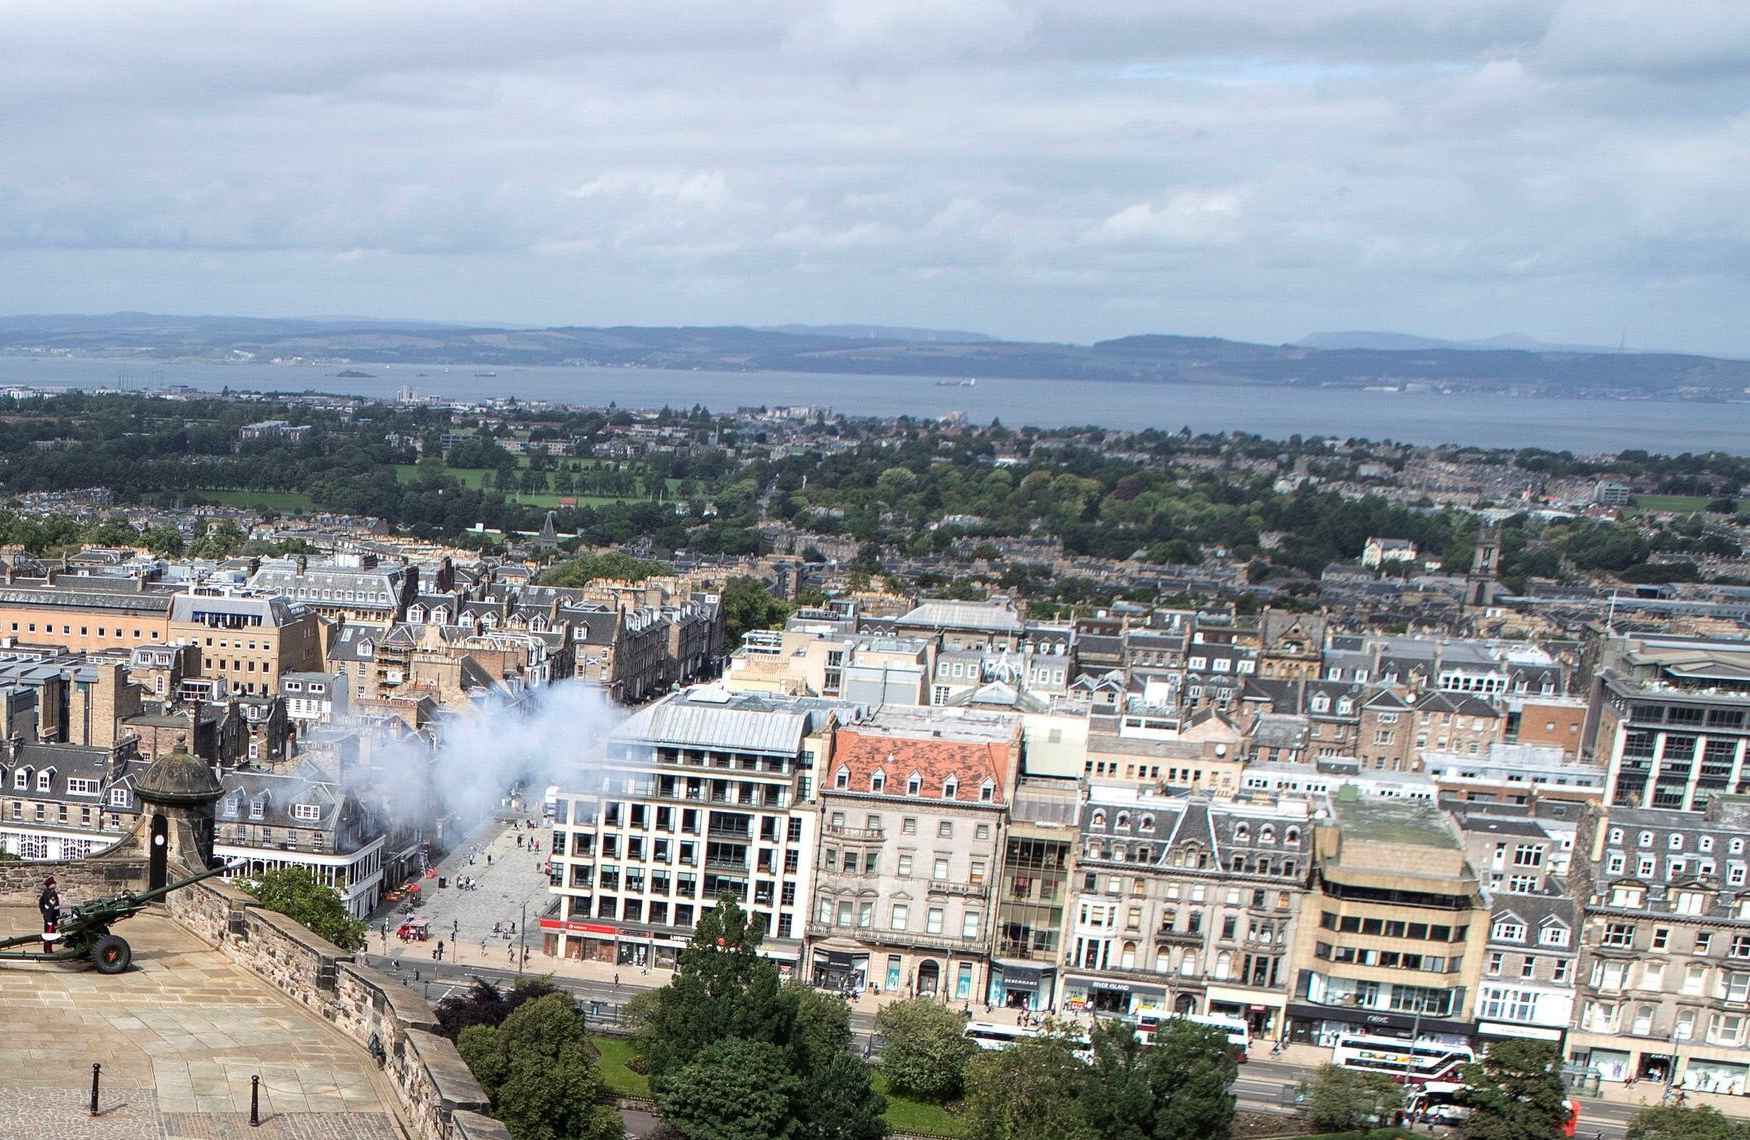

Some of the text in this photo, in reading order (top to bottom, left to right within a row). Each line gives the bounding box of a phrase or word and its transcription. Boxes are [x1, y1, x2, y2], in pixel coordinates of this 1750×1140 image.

[1004, 978, 1038, 986] DEBENHAMS
[1109, 982, 1130, 991] ISLAND
[1367, 1015, 1389, 1024] next
